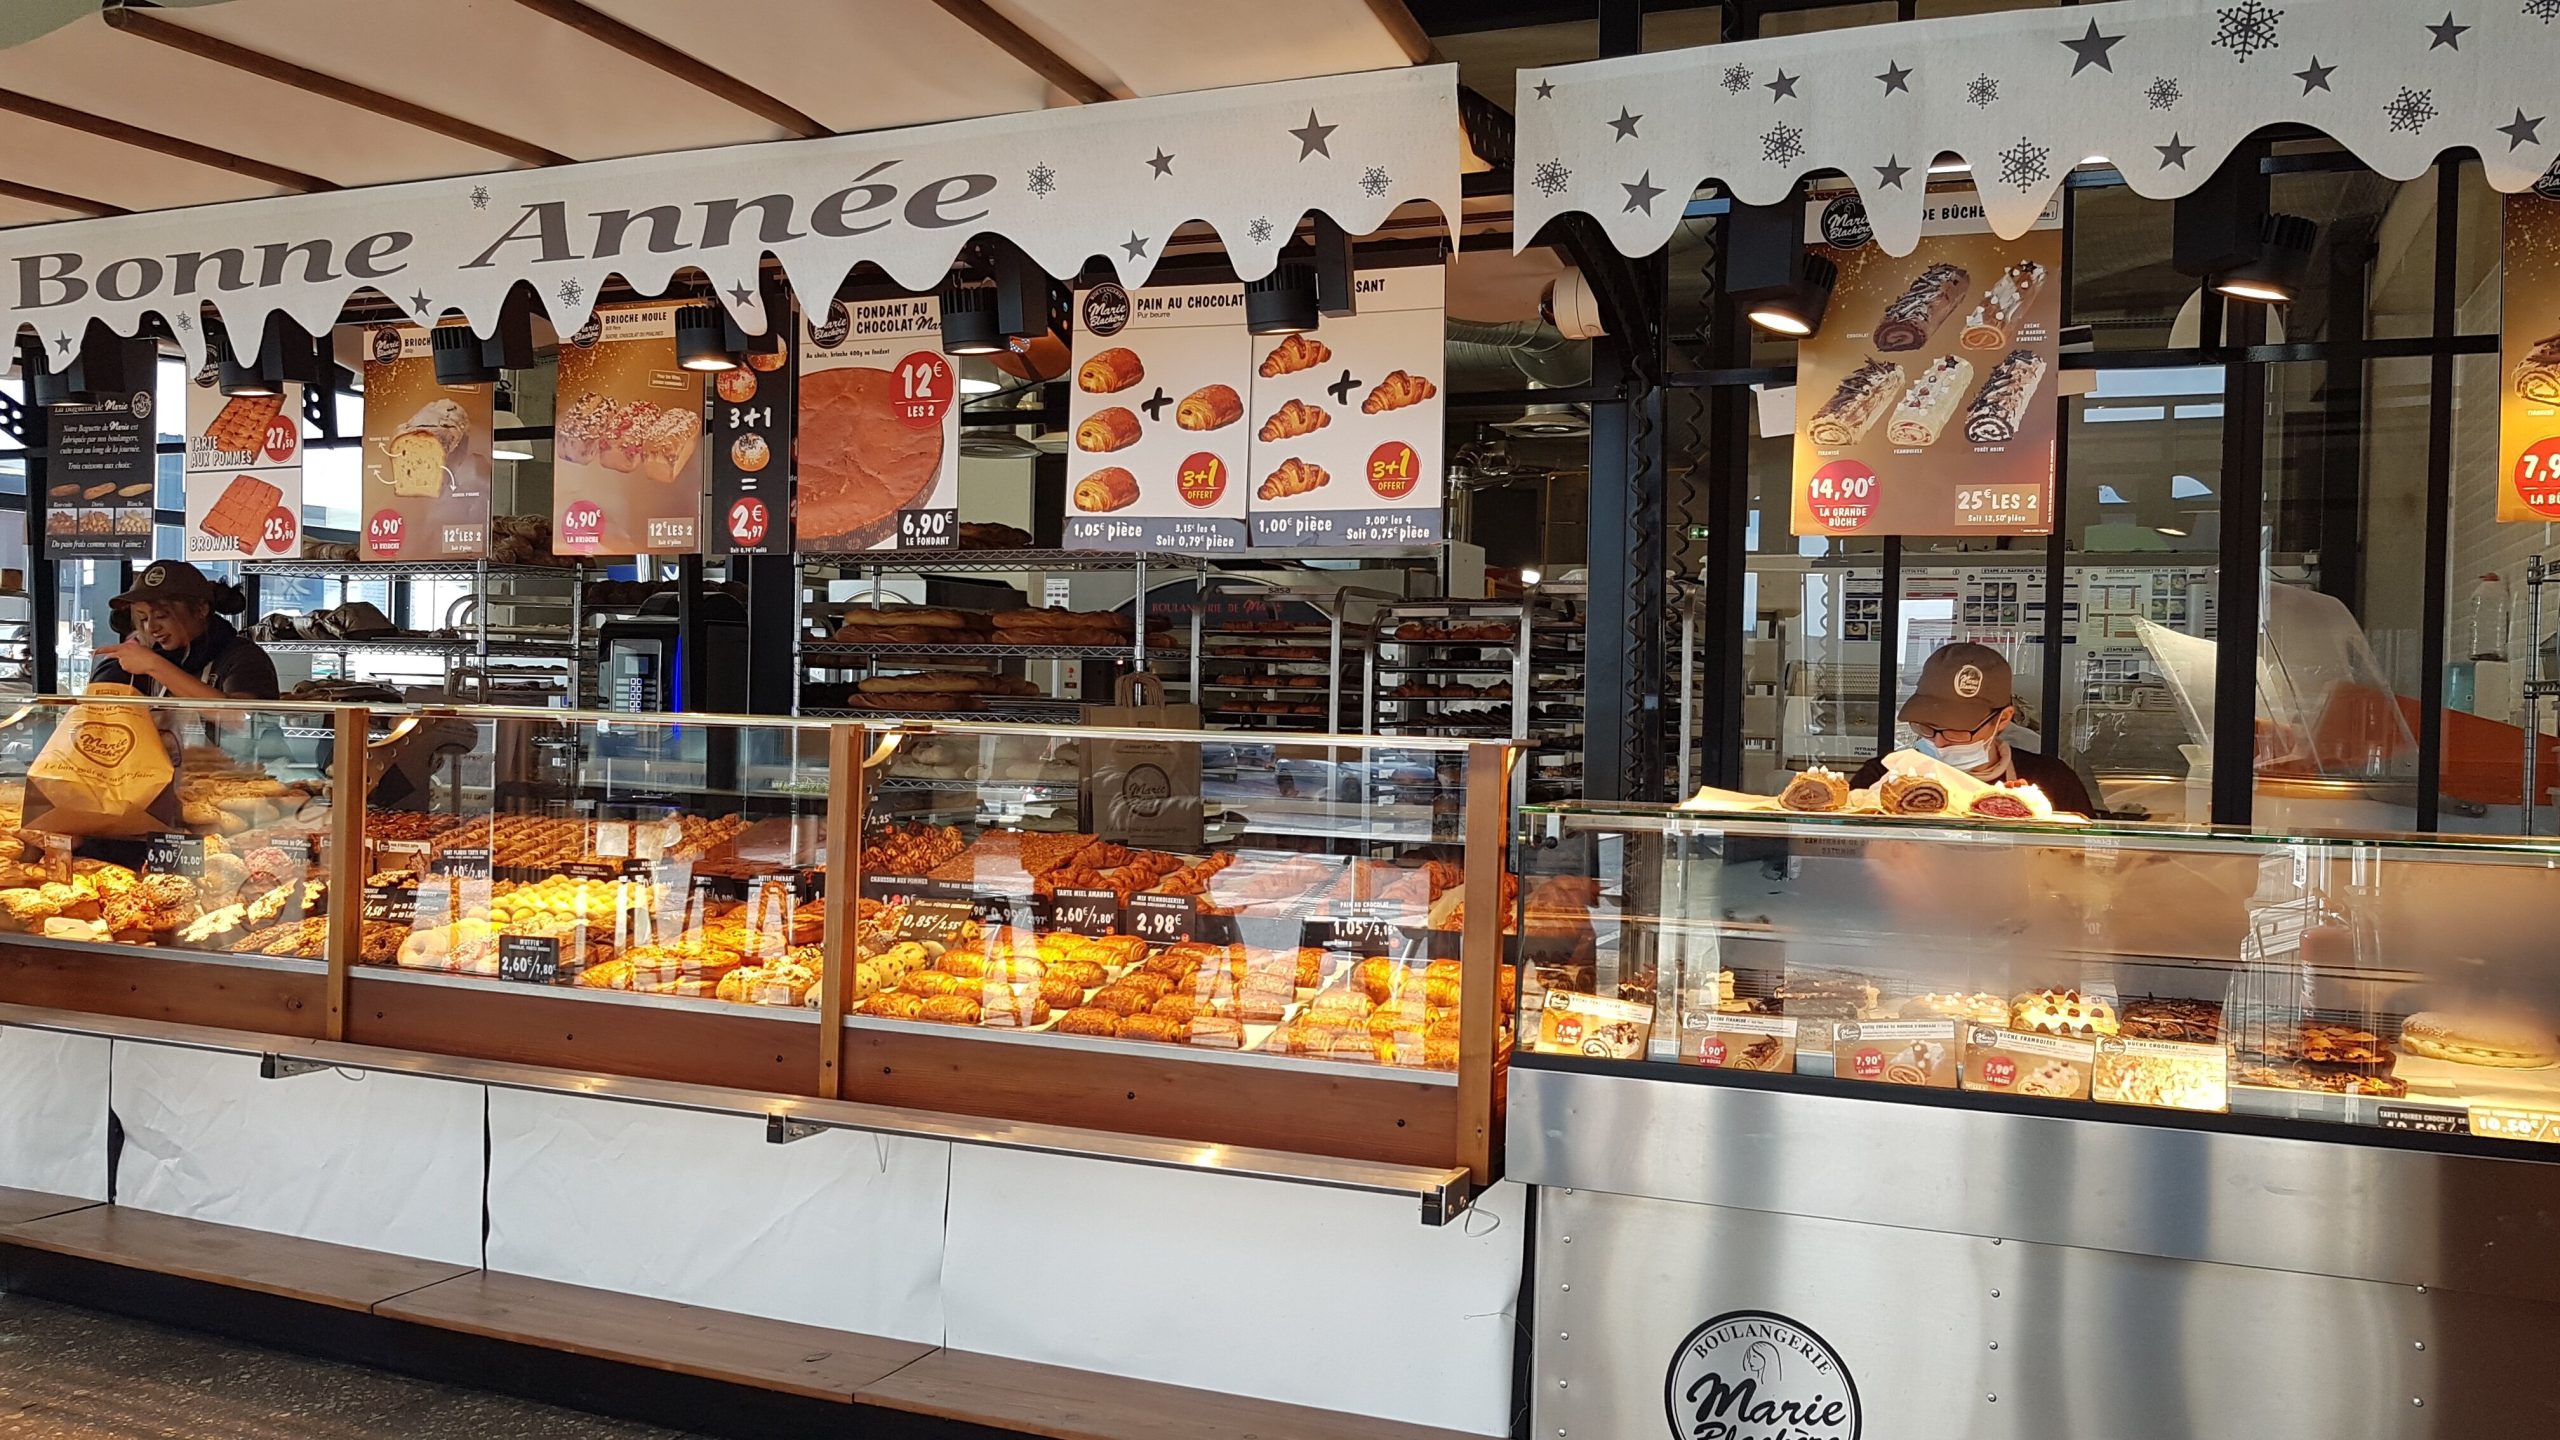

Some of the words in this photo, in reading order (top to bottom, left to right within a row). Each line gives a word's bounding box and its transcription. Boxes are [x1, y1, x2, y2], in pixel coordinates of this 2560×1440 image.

[1942, 203, 1985, 220] BÛCHE
[10, 231, 413, 310] Bonne
[457, 159, 998, 269] Année
[1355, 279, 1386, 294] SANT
[1087, 302, 1126, 317] Marie
[1137, 297, 1162, 311] PAIN
[1168, 296, 1182, 310] AU
[1188, 293, 1244, 309] CHOCOLAT
[605, 313, 638, 325] BRIOCHE
[641, 312, 667, 322] MOULE
[857, 303, 908, 320] FONDANT
[912, 302, 927, 315] AU
[1137, 311, 1148, 319] Pur
[1149, 311, 1171, 319] beurre
[856, 318, 913, 334] CHOCOLAT
[915, 315, 941, 331] Mar
[404, 336, 431, 347] BRIOCH
[729, 406, 773, 429] 3+1
[907, 405, 924, 418] LES
[927, 404, 935, 417] 2
[109, 420, 129, 431] Marie
[191, 436, 218, 451] TARTE
[191, 451, 212, 469] AUX
[213, 449, 254, 467] POMMES
[1372, 448, 1410, 479] 3+1
[1182, 458, 1219, 488] 3+1
[2523, 453, 2560, 482] 7,9
[1378, 480, 1405, 491] OFFERT
[1810, 475, 1876, 501] 14,90€
[1187, 489, 1213, 500] OFFERT
[1957, 488, 1992, 510] 25€
[1991, 494, 2021, 509] LES
[2027, 494, 2037, 509] 2
[2530, 493, 2544, 505] LA
[565, 509, 601, 529] 6,90€
[1819, 507, 1830, 517] LA
[1832, 507, 1867, 517] GRANDE
[1967, 513, 1982, 522] Soit
[2007, 513, 2026, 523] pièce
[371, 517, 403, 536] 6,90€
[902, 510, 953, 535] 6,90€
[1258, 518, 1293, 533] 1,00€
[1296, 517, 1333, 535] pièce
[1391, 515, 1403, 525] les
[1406, 515, 1412, 525] 4
[1828, 514, 1858, 527] BÛCHE
[667, 523, 685, 536] LES
[686, 525, 693, 536] 2
[1073, 522, 1105, 537] 1,05€
[1107, 521, 1143, 540] pièce
[1197, 524, 1208, 533] les
[1210, 524, 1216, 533] 4
[1346, 527, 1368, 541] Soit
[1369, 526, 1398, 541] 0,75€
[1399, 525, 1430, 542] pièce
[190, 535, 240, 552] BROWNIE
[460, 531, 473, 543] LES
[476, 531, 482, 542] 2
[566, 535, 574, 543] LA
[575, 535, 599, 544] BRIOCHE
[906, 536, 915, 546] LE
[916, 535, 950, 546] FONDANT
[1155, 534, 1176, 548] Soit
[1178, 534, 1205, 548] 0,79€
[1206, 533, 1235, 550] pièce
[379, 542, 400, 550] BRIOCHE
[80, 733, 128, 750] Marie
[44, 762, 56, 771] Le
[1128, 782, 1166, 796] Marie
[870, 875, 896, 884] CHAUSSON
[897, 877, 907, 885] AUX
[907, 877, 928, 885] POMMES
[1056, 889, 1073, 897] TARTE
[1073, 889, 1087, 898] MIEL
[1088, 890, 1114, 899] AMANDES
[1147, 896, 1185, 905] VIENNOISERIES
[1136, 912, 1183, 935] 2,98€
[1856, 1053, 1882, 1066] 7,90€
[2380, 1110, 2399, 1119] TARTE
[2400, 1112, 2422, 1121] POIRES
[2423, 1114, 2455, 1123] CHOCOLAT
[1692, 1323, 1833, 1377] BOULANGERIE
[1686, 1372, 1846, 1427] Marie
